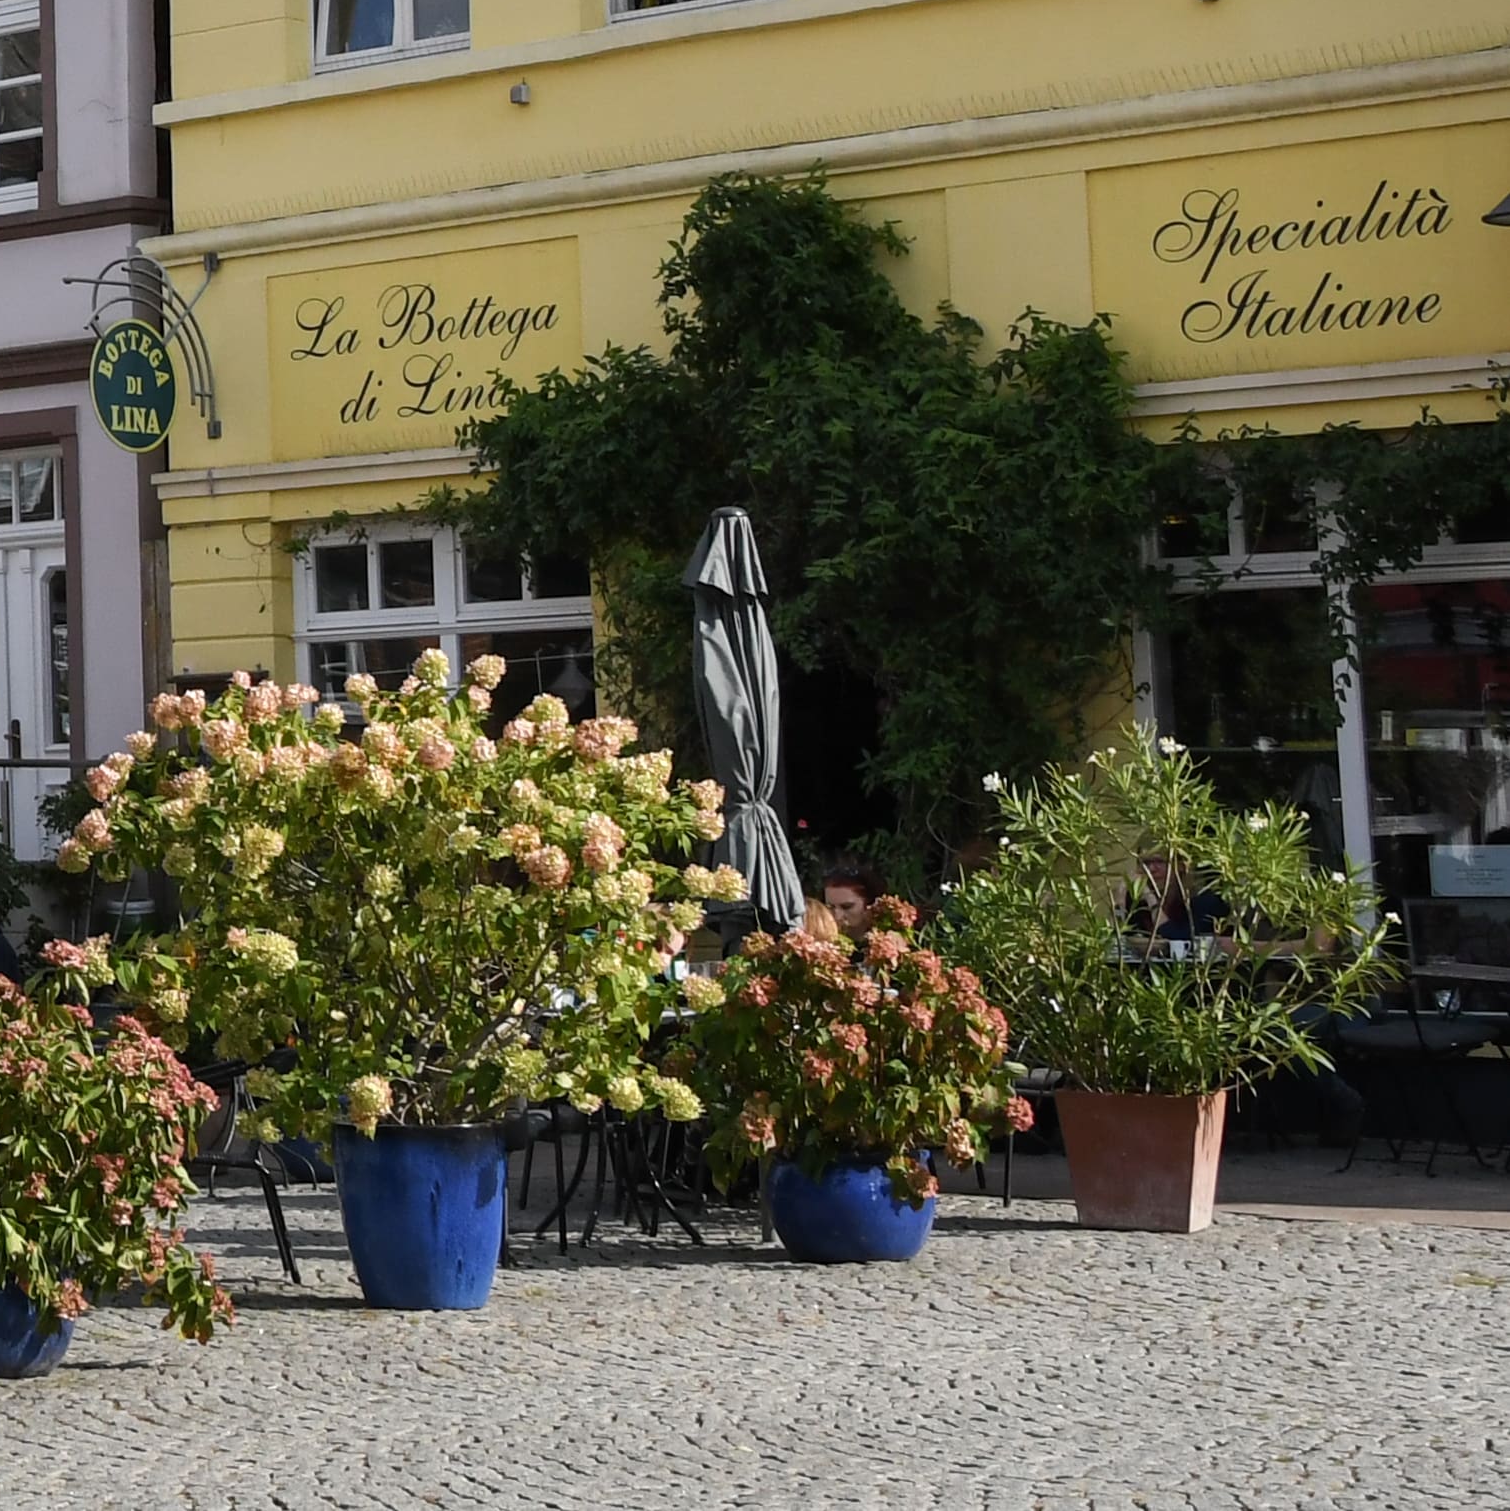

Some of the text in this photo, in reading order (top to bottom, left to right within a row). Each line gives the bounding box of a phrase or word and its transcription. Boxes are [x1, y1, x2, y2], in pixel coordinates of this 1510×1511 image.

[1152, 179, 1454, 284] Specialità
[290, 284, 560, 361] La Bottega
[1181, 269, 1442, 343] Italiane
[98, 329, 170, 387] BOTTEGA
[125, 375, 143, 395] DI
[110, 404, 161, 434] LINA
[340, 370, 382, 424] di
